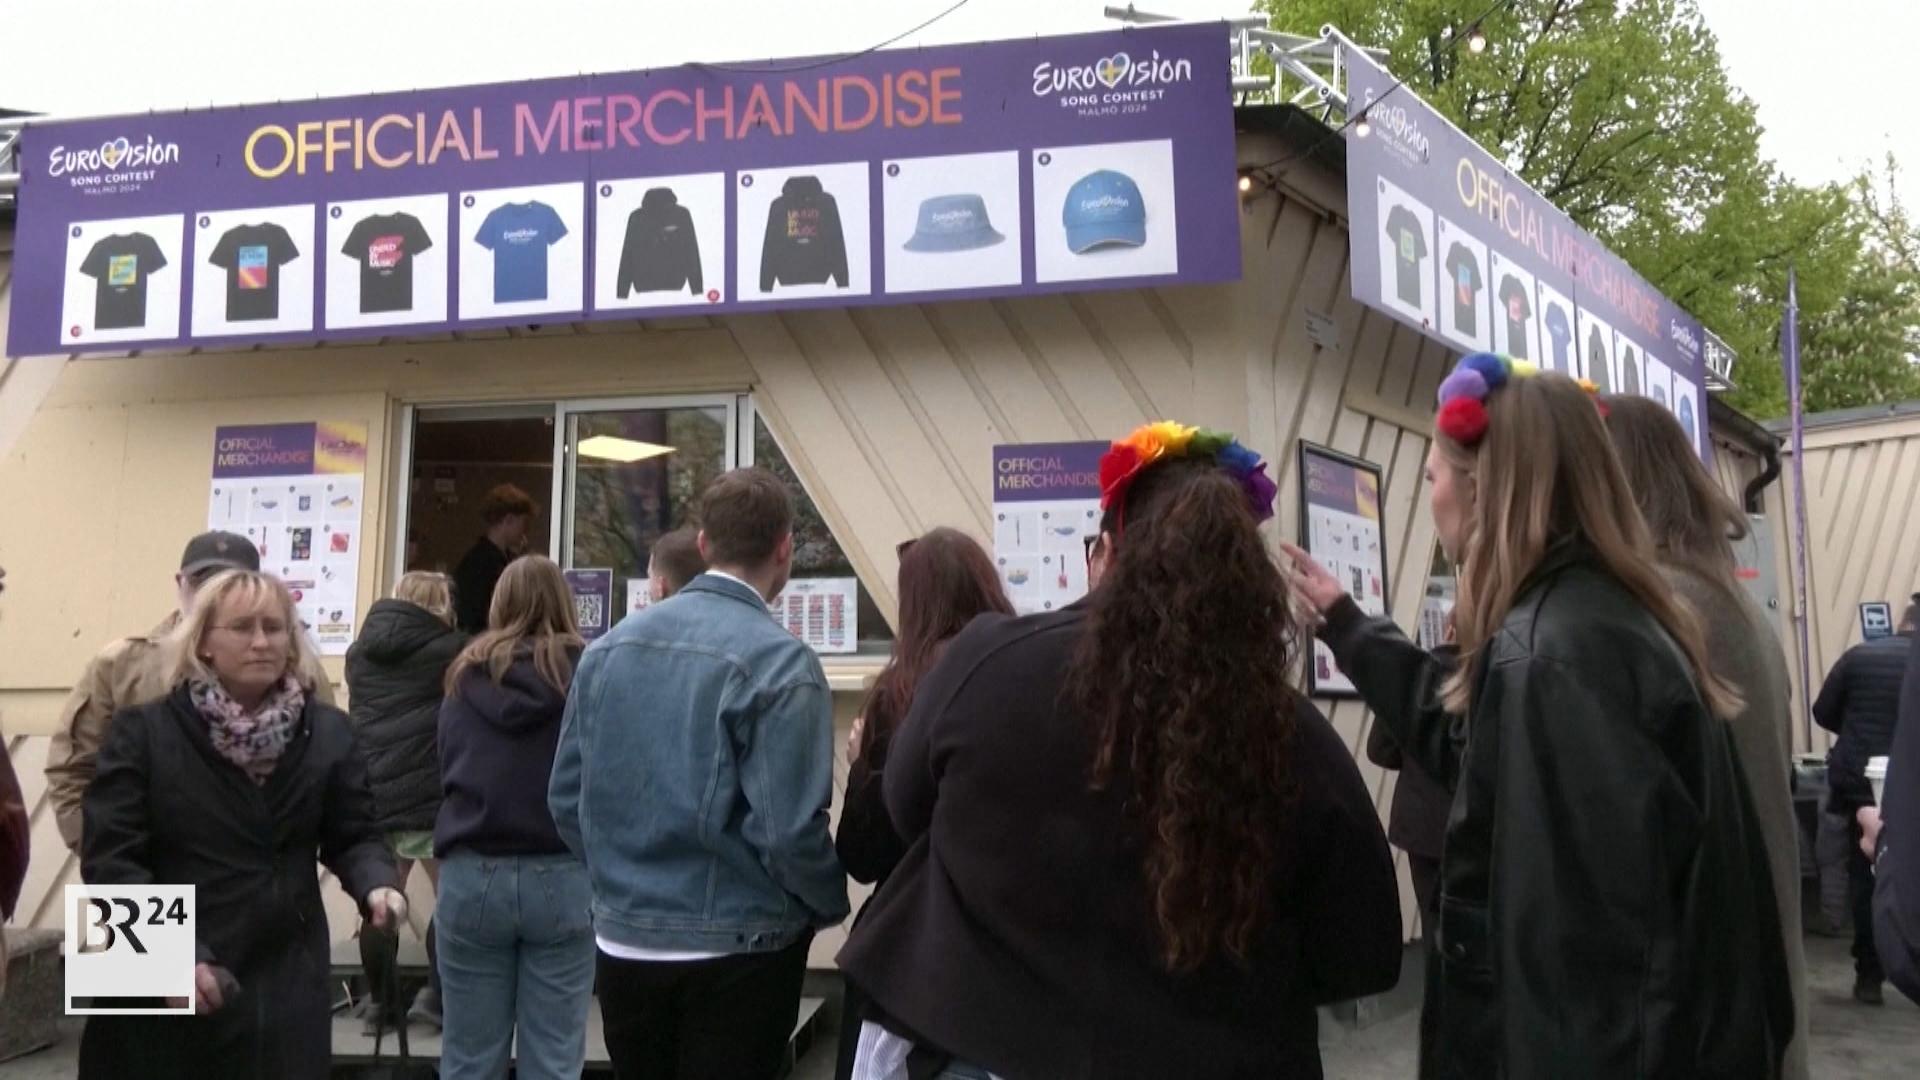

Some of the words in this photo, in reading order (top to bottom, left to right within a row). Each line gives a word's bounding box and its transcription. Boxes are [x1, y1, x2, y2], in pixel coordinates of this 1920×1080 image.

[1061, 94, 1098, 107] SONG
[1103, 89, 1165, 103] CONTEST
[245, 107, 499, 178] OFFICIAL
[515, 68, 962, 156] MERCHANDISE
[70, 174, 101, 187] SONG
[105, 170, 156, 184] CONTEST
[1457, 158, 1549, 260] OFFICIAL
[1552, 225, 1661, 338] MERCHANDISE
[219, 437, 276, 452] OFFICIAL
[218, 451, 309, 467] MERCHANDISE
[999, 458, 1065, 473] OFFICIAL
[999, 472, 1099, 489] MERCHANDIS
